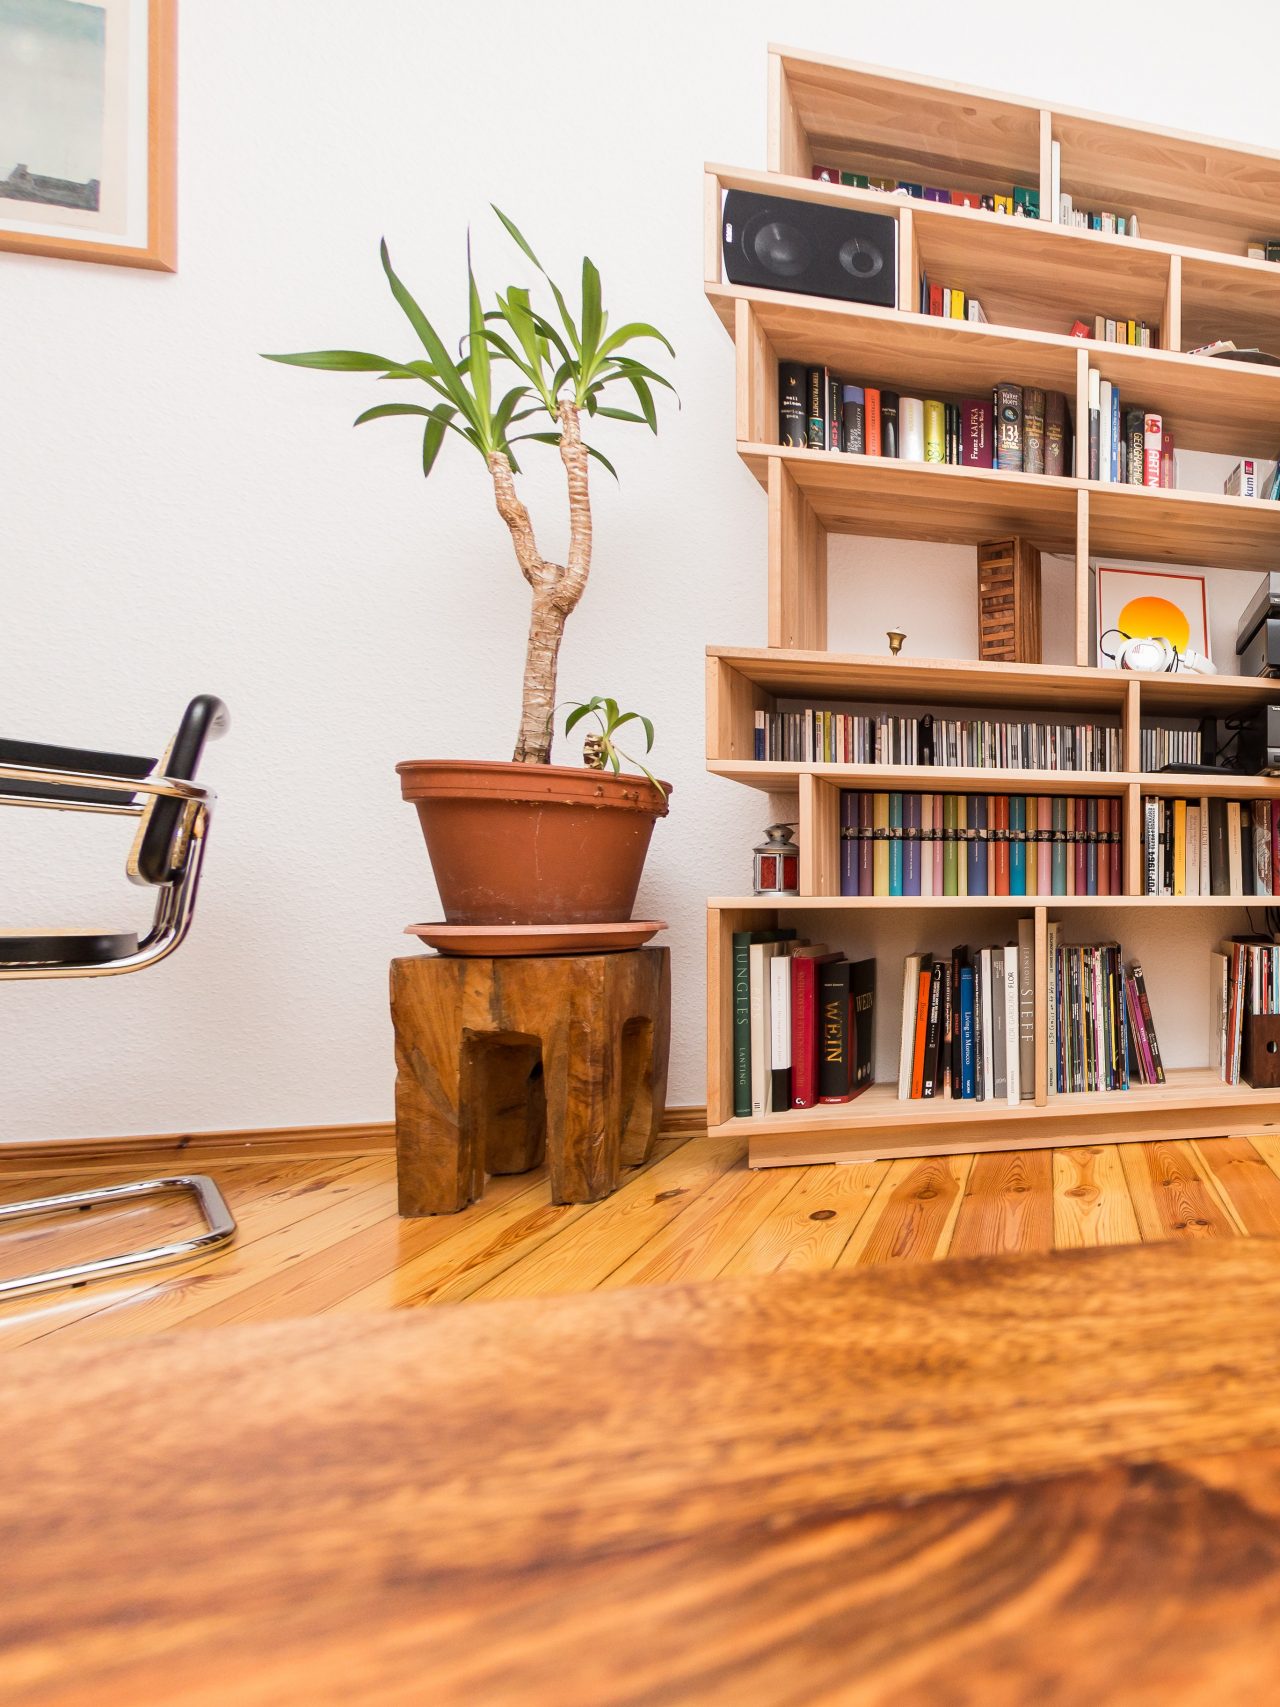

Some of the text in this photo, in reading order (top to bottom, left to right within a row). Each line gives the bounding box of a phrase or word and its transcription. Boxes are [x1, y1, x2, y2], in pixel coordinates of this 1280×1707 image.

[970, 408, 978, 460] Franz KAFKA
[1148, 450, 1160, 475] ART
[1147, 851, 1155, 873] 1964
[1147, 876, 1155, 893] POP
[735, 945, 749, 1026] JUNGLES
[856, 992, 874, 1013] WEIN
[1021, 988, 1034, 1042] SIEFF
[824, 1000, 843, 1063] WEIN
[964, 1011, 972, 1029] Living
[739, 1047, 747, 1085] LANTING
